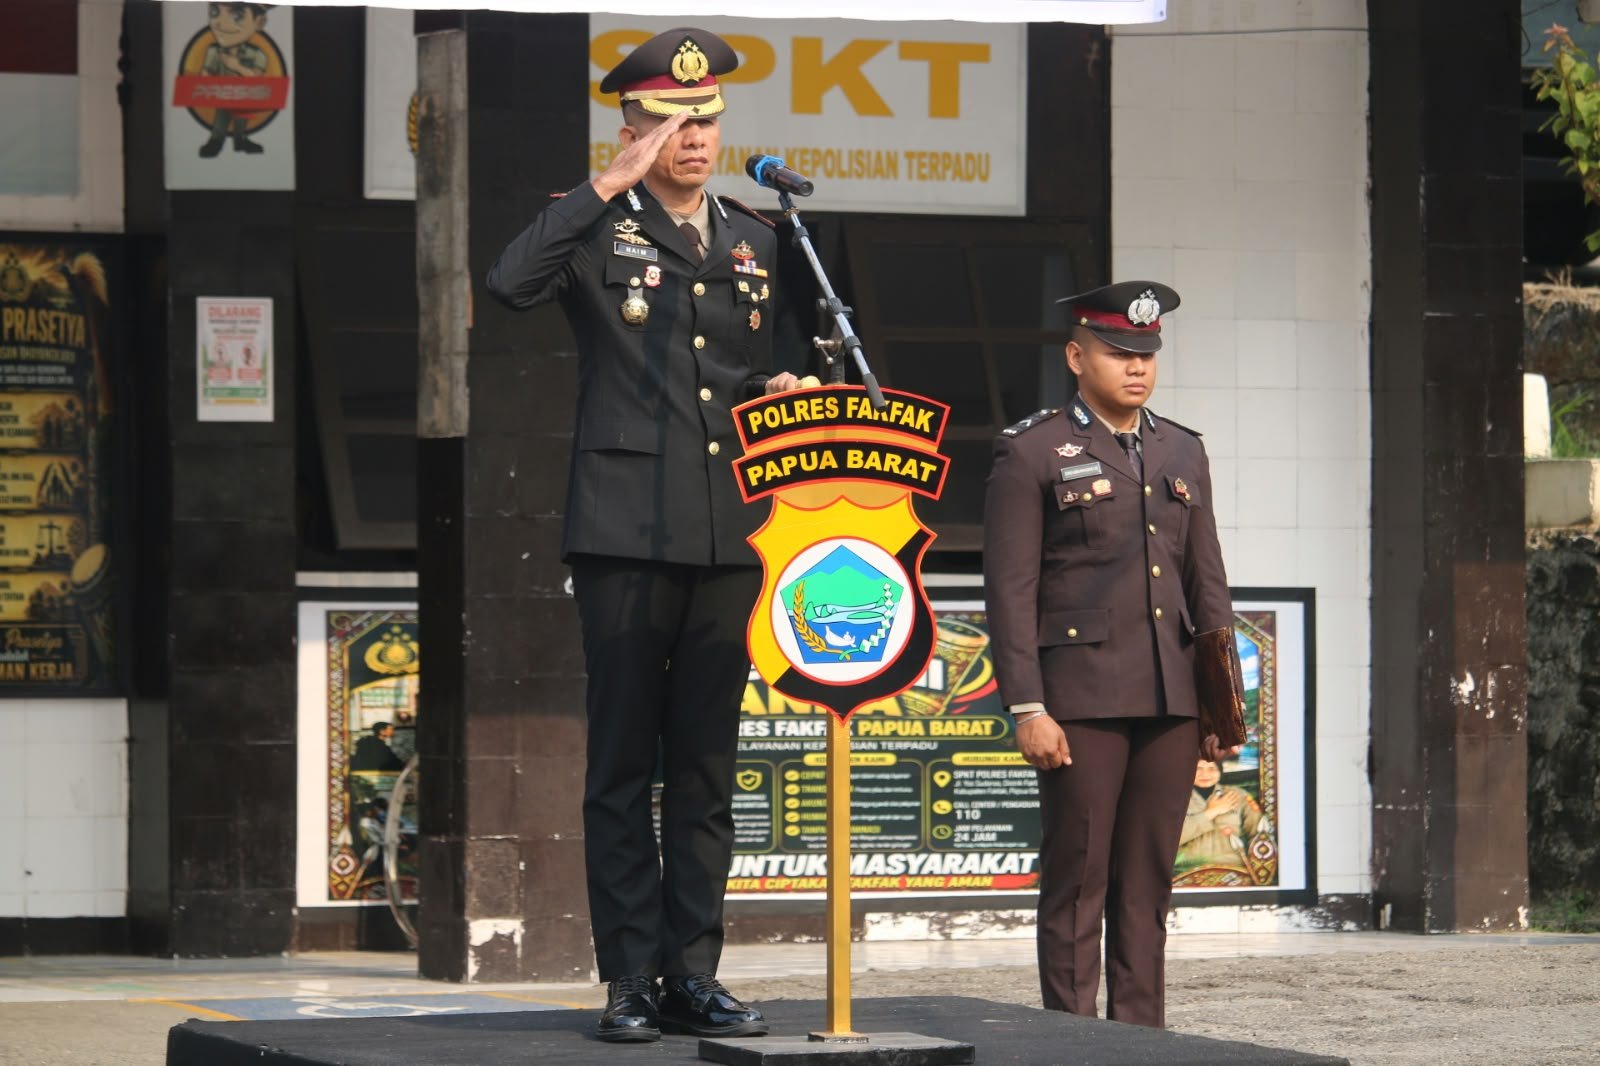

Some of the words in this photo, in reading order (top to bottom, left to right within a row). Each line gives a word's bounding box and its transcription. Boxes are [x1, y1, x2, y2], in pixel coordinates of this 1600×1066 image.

[785, 147, 898, 180] KEPOLISIAN
[904, 151, 990, 182] TERPADU
[2, 306, 86, 347] PRASETYA
[748, 397, 839, 435] POLRES
[746, 450, 838, 486] PAPUA
[847, 450, 937, 482] BARAT
[858, 720, 925, 736] PAPUA
[929, 720, 995, 736] BARAT
[737, 741, 800, 751] ELAYANAN
[881, 741, 938, 751] TERPADU
[955, 809, 981, 820] 110
[954, 832, 970, 842] 24
[971, 832, 997, 842] JAM
[765, 877, 827, 890] CIPTAKA
[905, 876, 946, 888] YANG
[947, 876, 994, 888] AMAN
